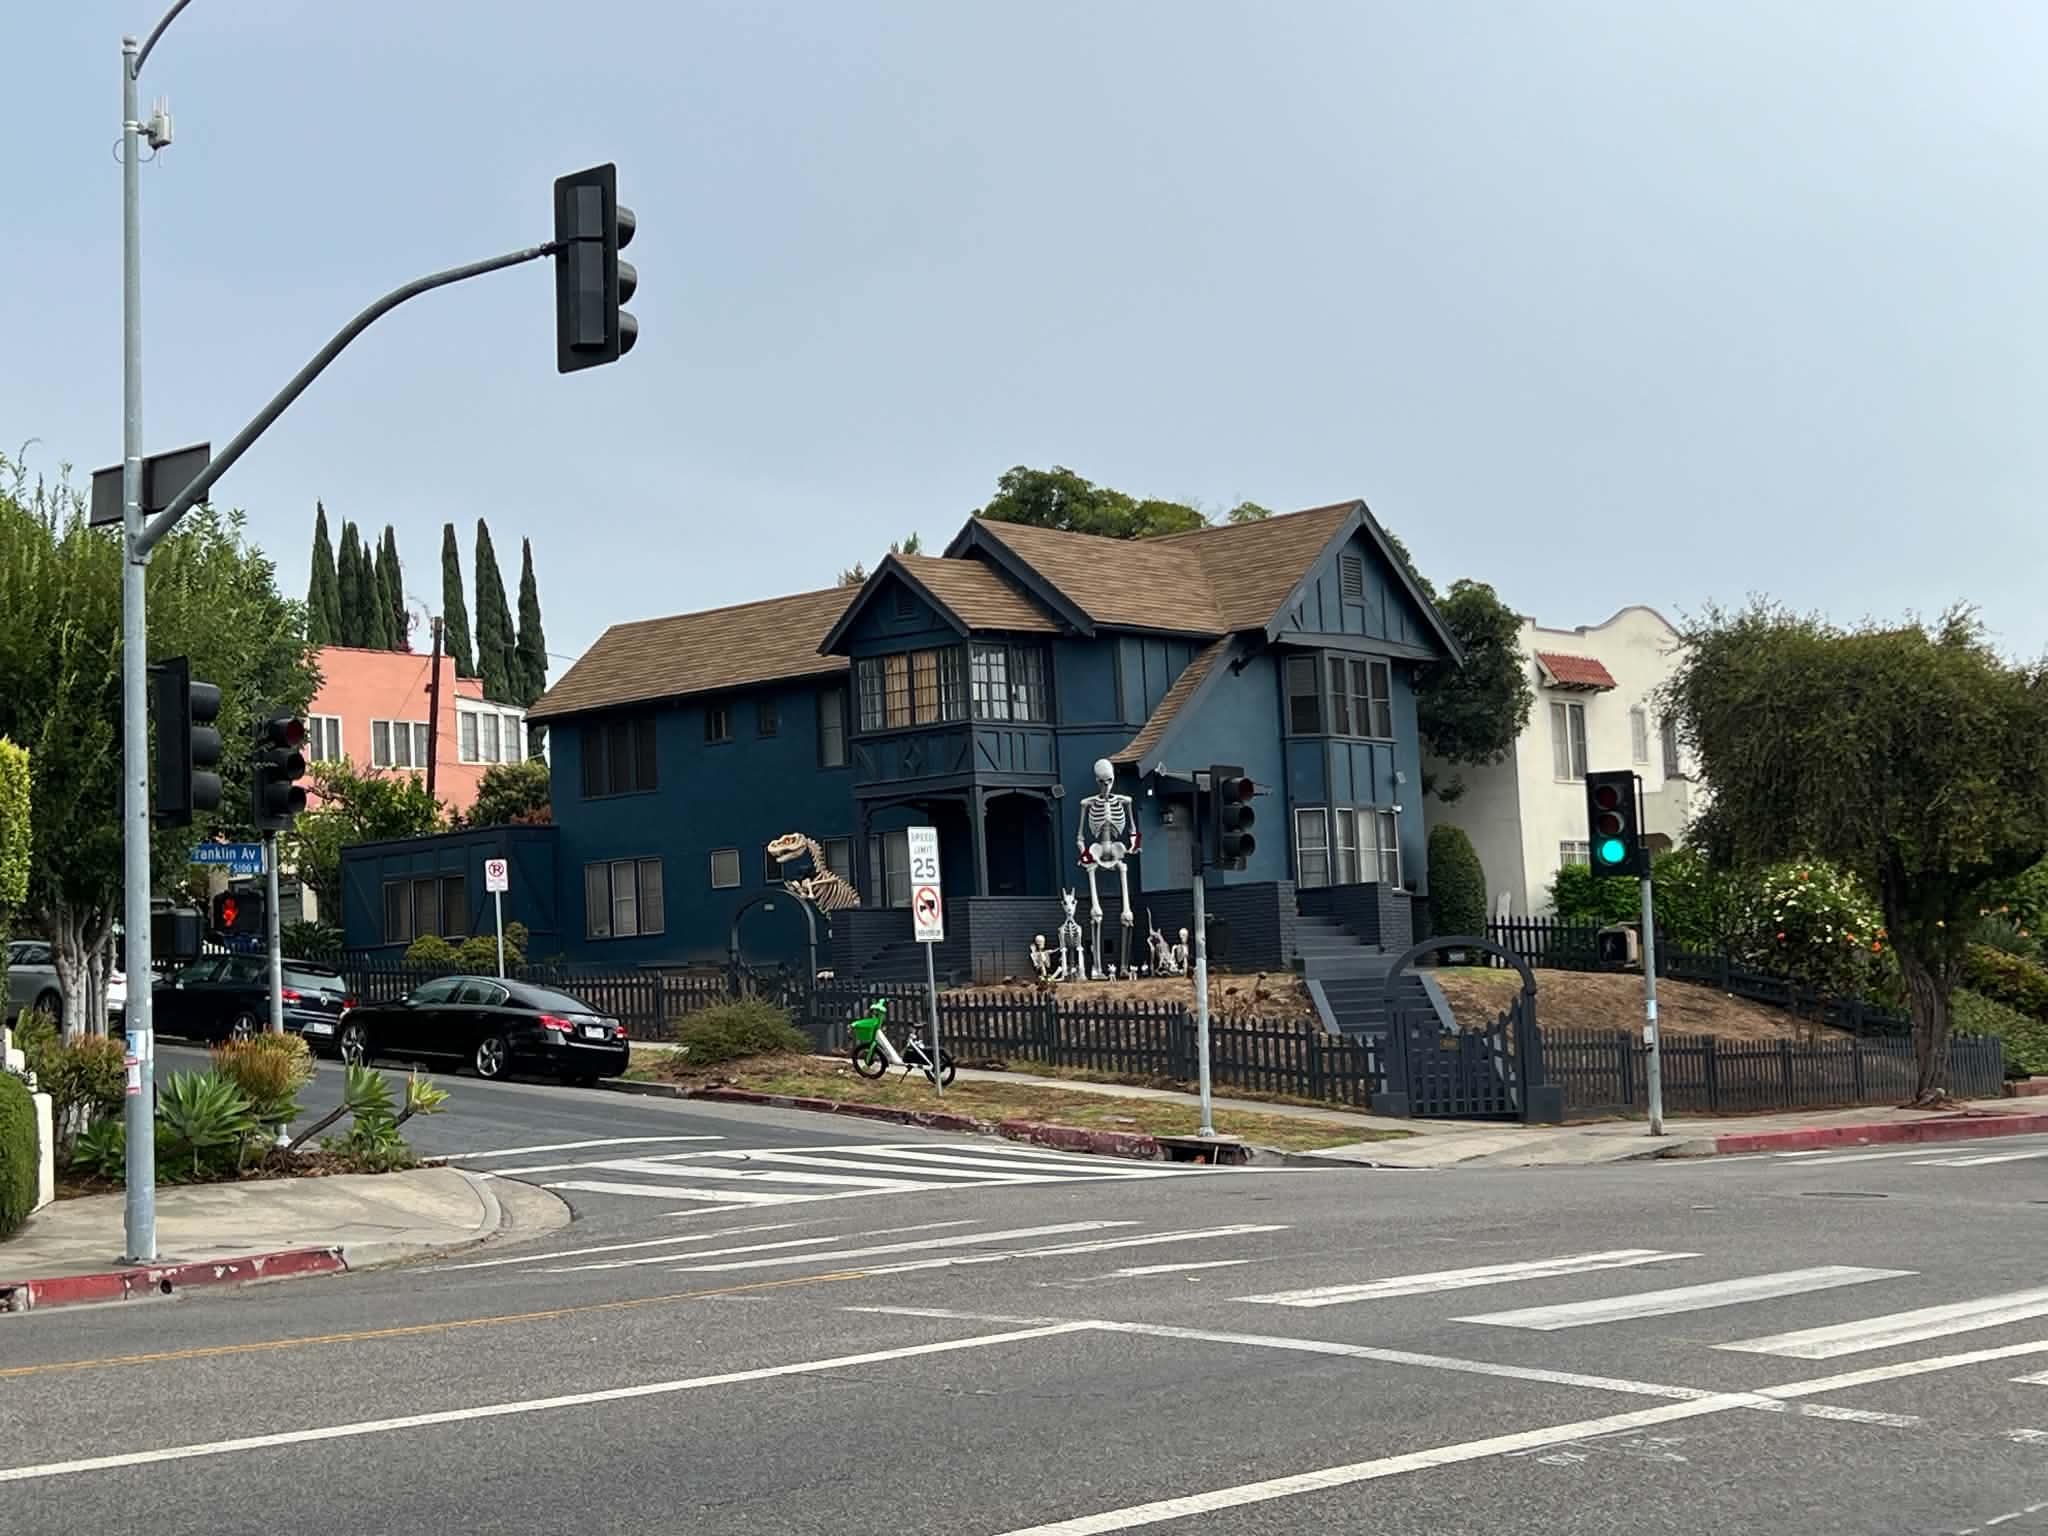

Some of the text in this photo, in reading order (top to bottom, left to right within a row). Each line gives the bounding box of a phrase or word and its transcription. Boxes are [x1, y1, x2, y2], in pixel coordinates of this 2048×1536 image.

[911, 832, 936, 842] SPEED
[194, 847, 256, 860] ranklin Av
[914, 846, 932, 855] LIMIT
[913, 858, 936, 878] 25
